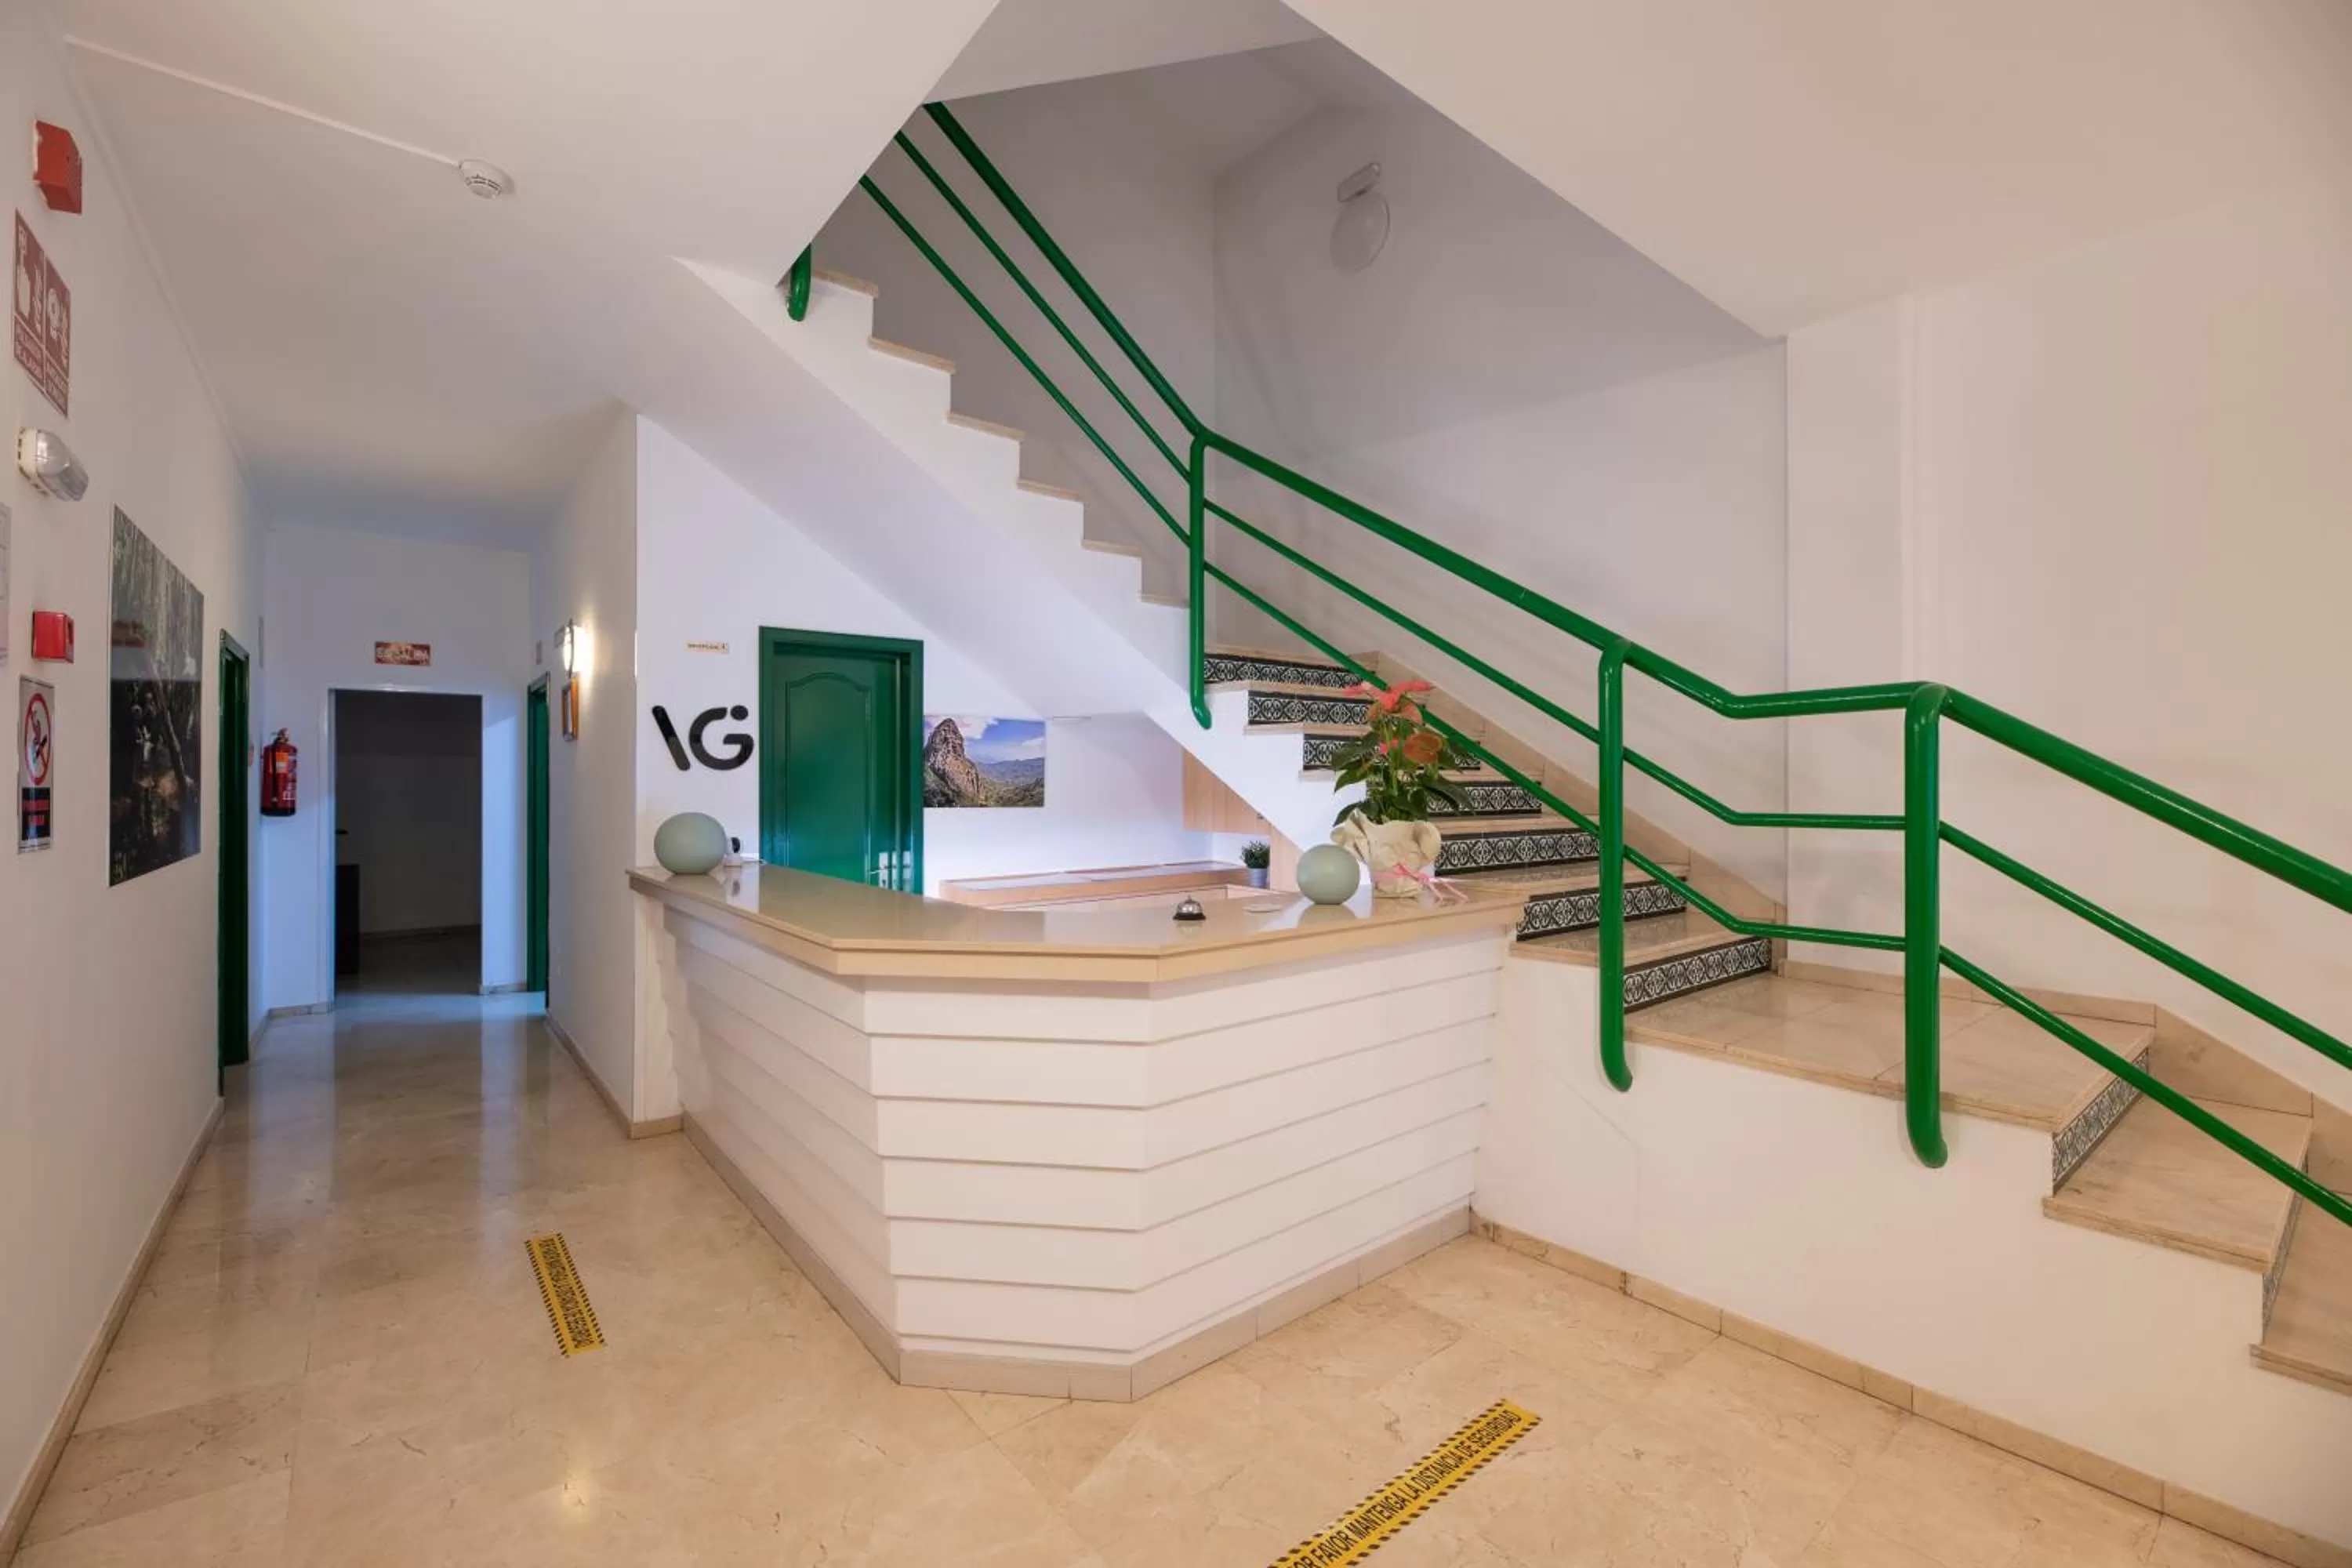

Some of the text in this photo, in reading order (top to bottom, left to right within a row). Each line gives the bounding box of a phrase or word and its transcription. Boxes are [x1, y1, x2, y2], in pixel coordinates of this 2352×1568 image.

[1466, 1410, 1521, 1449] SEGURIDAD
[1454, 1440, 1480, 1457] DE
[1410, 1449, 1468, 1491] DISTANCIA
[1397, 1480, 1425, 1501] LA
[1344, 1491, 1412, 1541] MANTENGA
[1310, 1530, 1359, 1566] FAVOR
